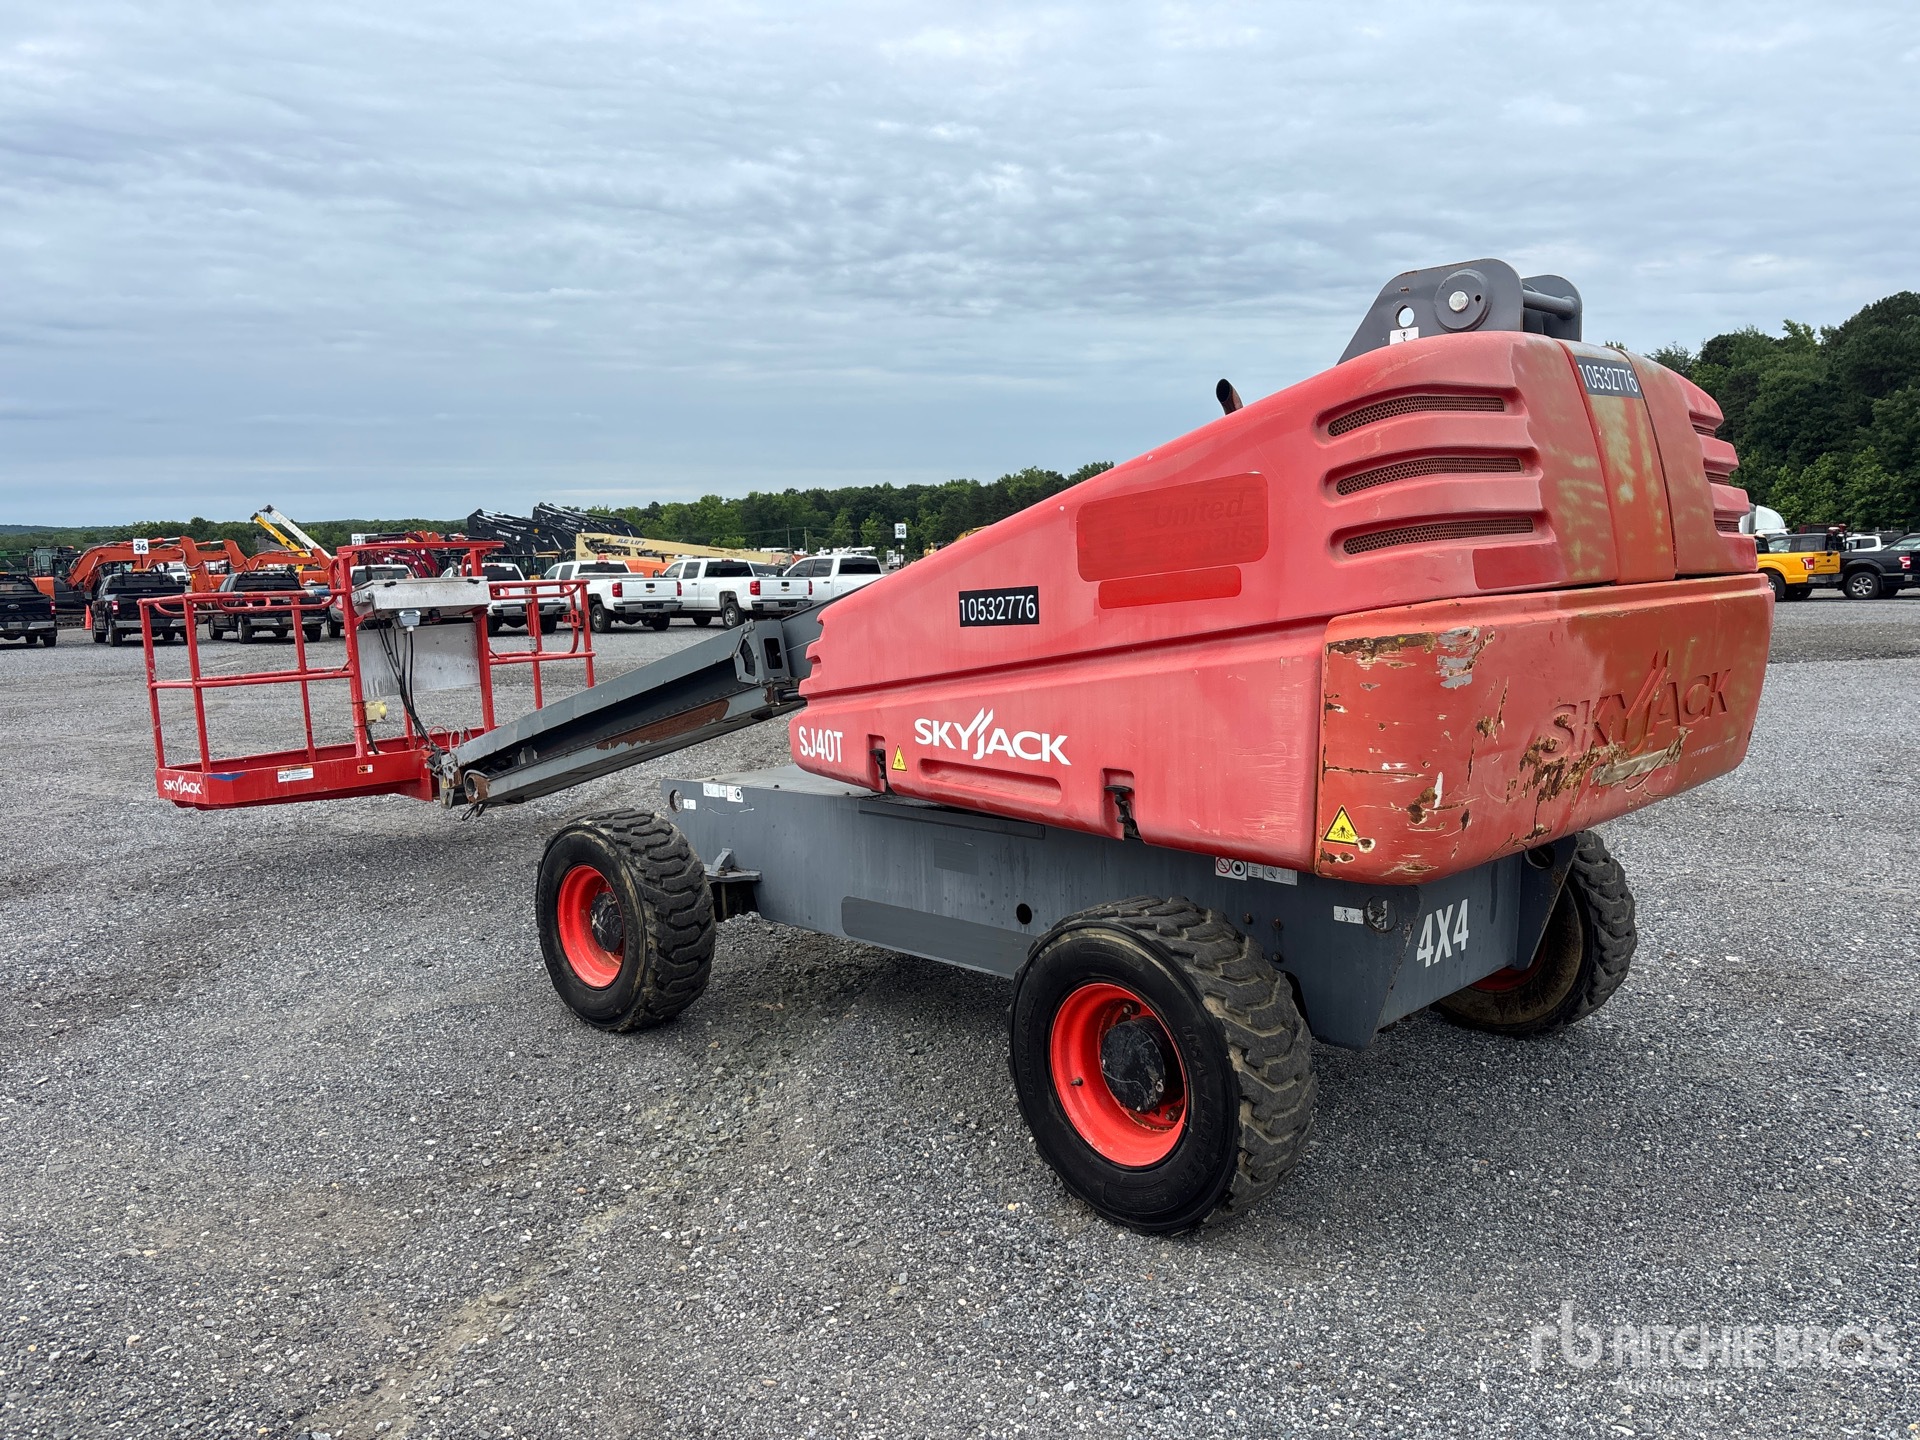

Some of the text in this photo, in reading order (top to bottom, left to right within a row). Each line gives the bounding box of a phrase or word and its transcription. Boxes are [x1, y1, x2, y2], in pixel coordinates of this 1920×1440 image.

[1578, 364, 1638, 393] 10532776
[960, 594, 1036, 621] 10532776
[1539, 650, 1732, 762] SKYJACK
[799, 726, 843, 763] SJ40T
[914, 707, 1072, 766] SKYJACK
[163, 774, 202, 795] SKYJACK
[1416, 898, 1469, 968] 4X4
